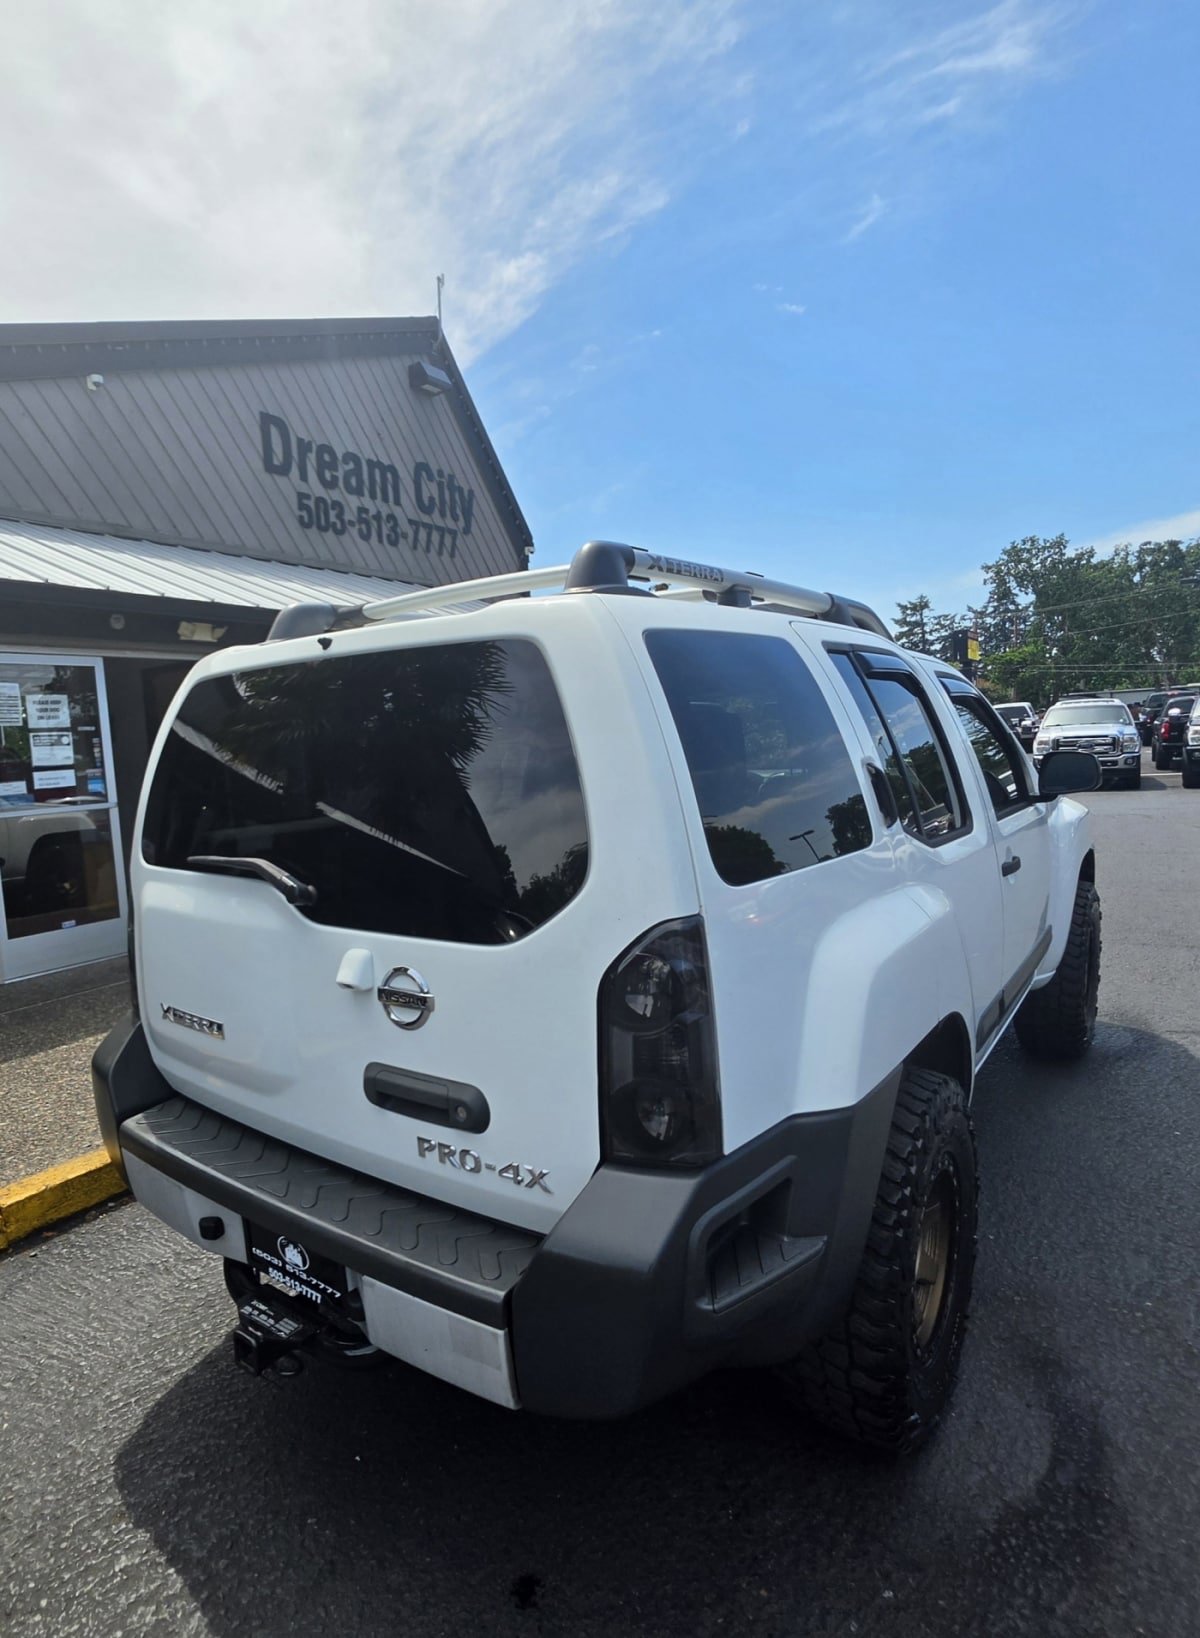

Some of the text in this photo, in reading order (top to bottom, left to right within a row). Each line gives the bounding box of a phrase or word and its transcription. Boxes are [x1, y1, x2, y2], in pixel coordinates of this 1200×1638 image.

[259, 411, 475, 535] Dream City
[296, 491, 458, 558] 503-513-7777
[647, 553, 724, 582] XTERRA
[379, 989, 428, 1009] NISSAN
[416, 1135, 554, 1194] PRO-4X
[252, 1247, 283, 1267] (503)
